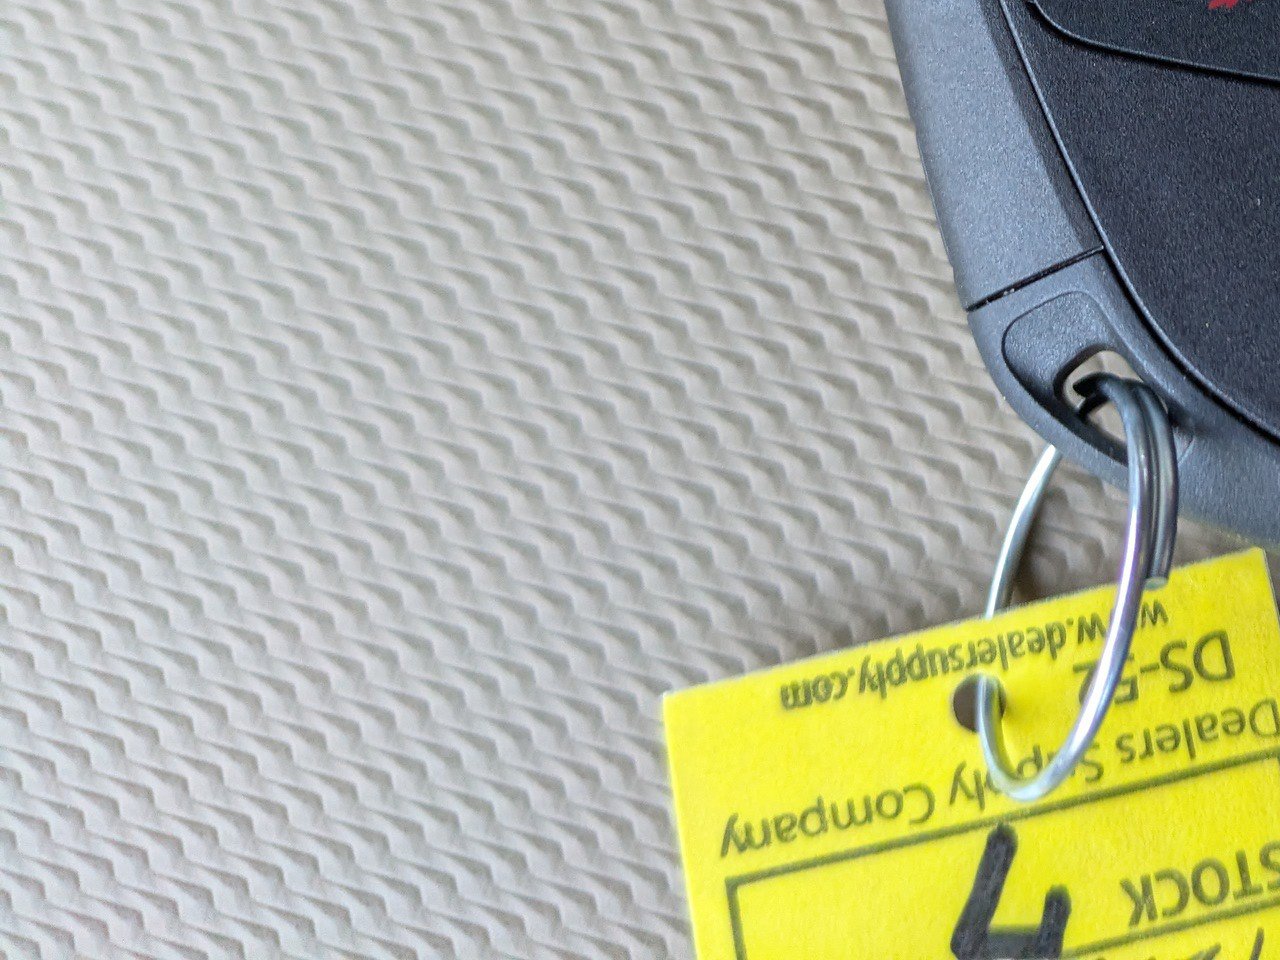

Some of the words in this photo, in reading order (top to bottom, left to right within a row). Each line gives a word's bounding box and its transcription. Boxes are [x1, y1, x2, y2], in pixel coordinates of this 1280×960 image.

[779, 599, 1169, 710] ww.dealersupply.com
[949, 744, 1105, 811] Sply
[720, 782, 936, 858] Company
